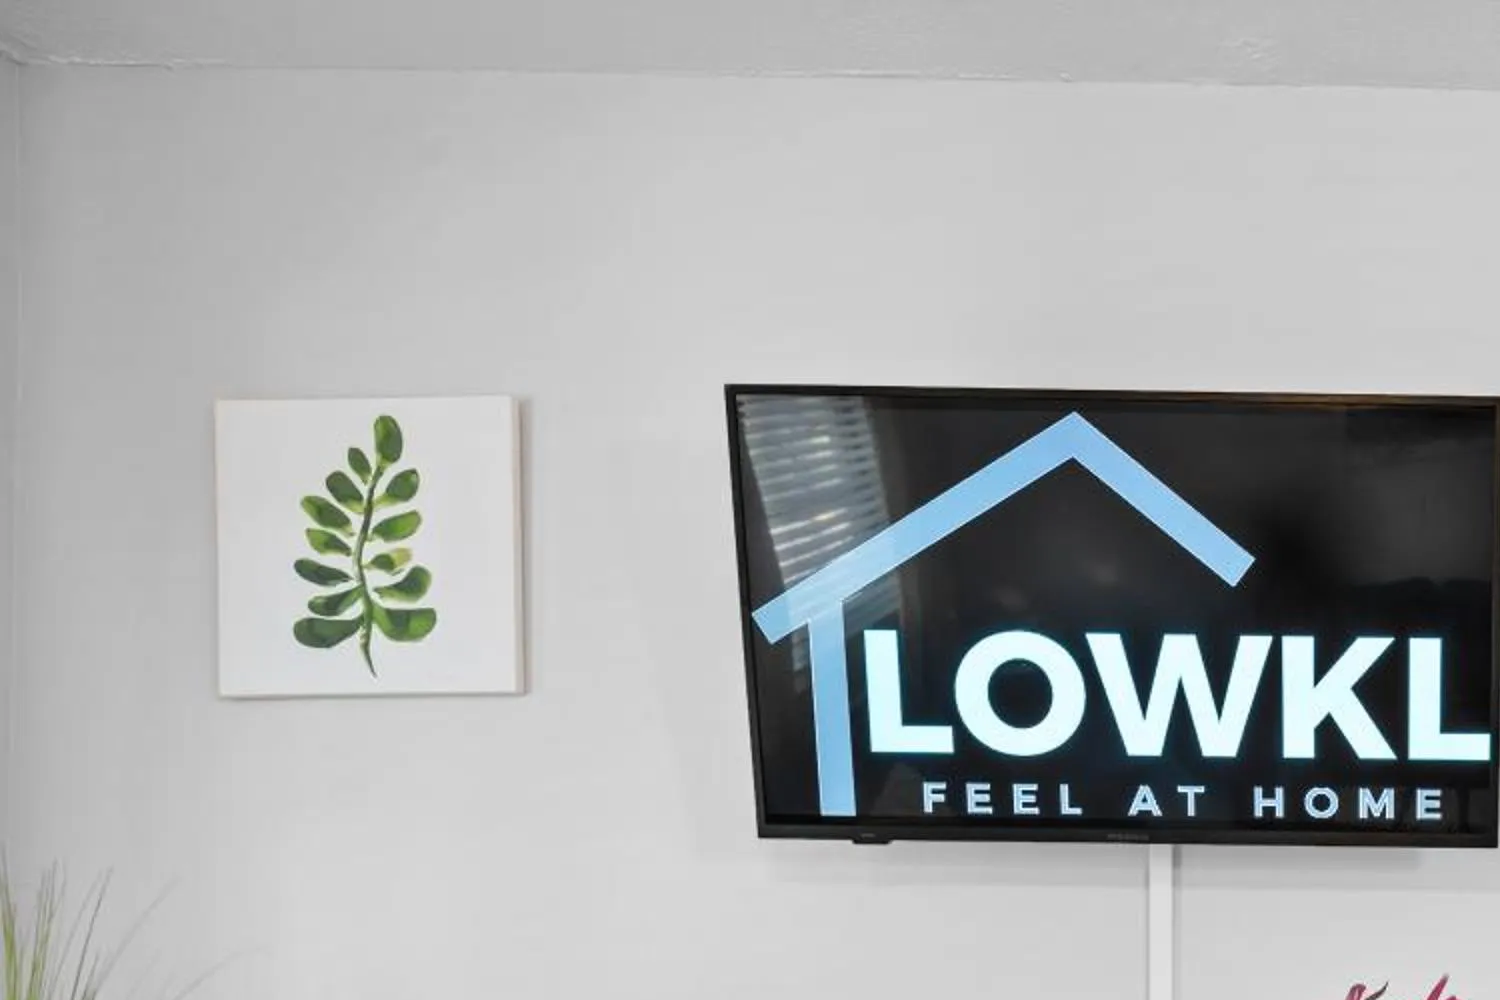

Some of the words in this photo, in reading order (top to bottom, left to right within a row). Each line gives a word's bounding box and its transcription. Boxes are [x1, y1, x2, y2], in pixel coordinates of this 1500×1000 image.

[863, 629, 1492, 761] LOWKL
[922, 781, 1083, 816] FEEL
[1127, 784, 1206, 817] AT
[1253, 786, 1443, 821] HOME
